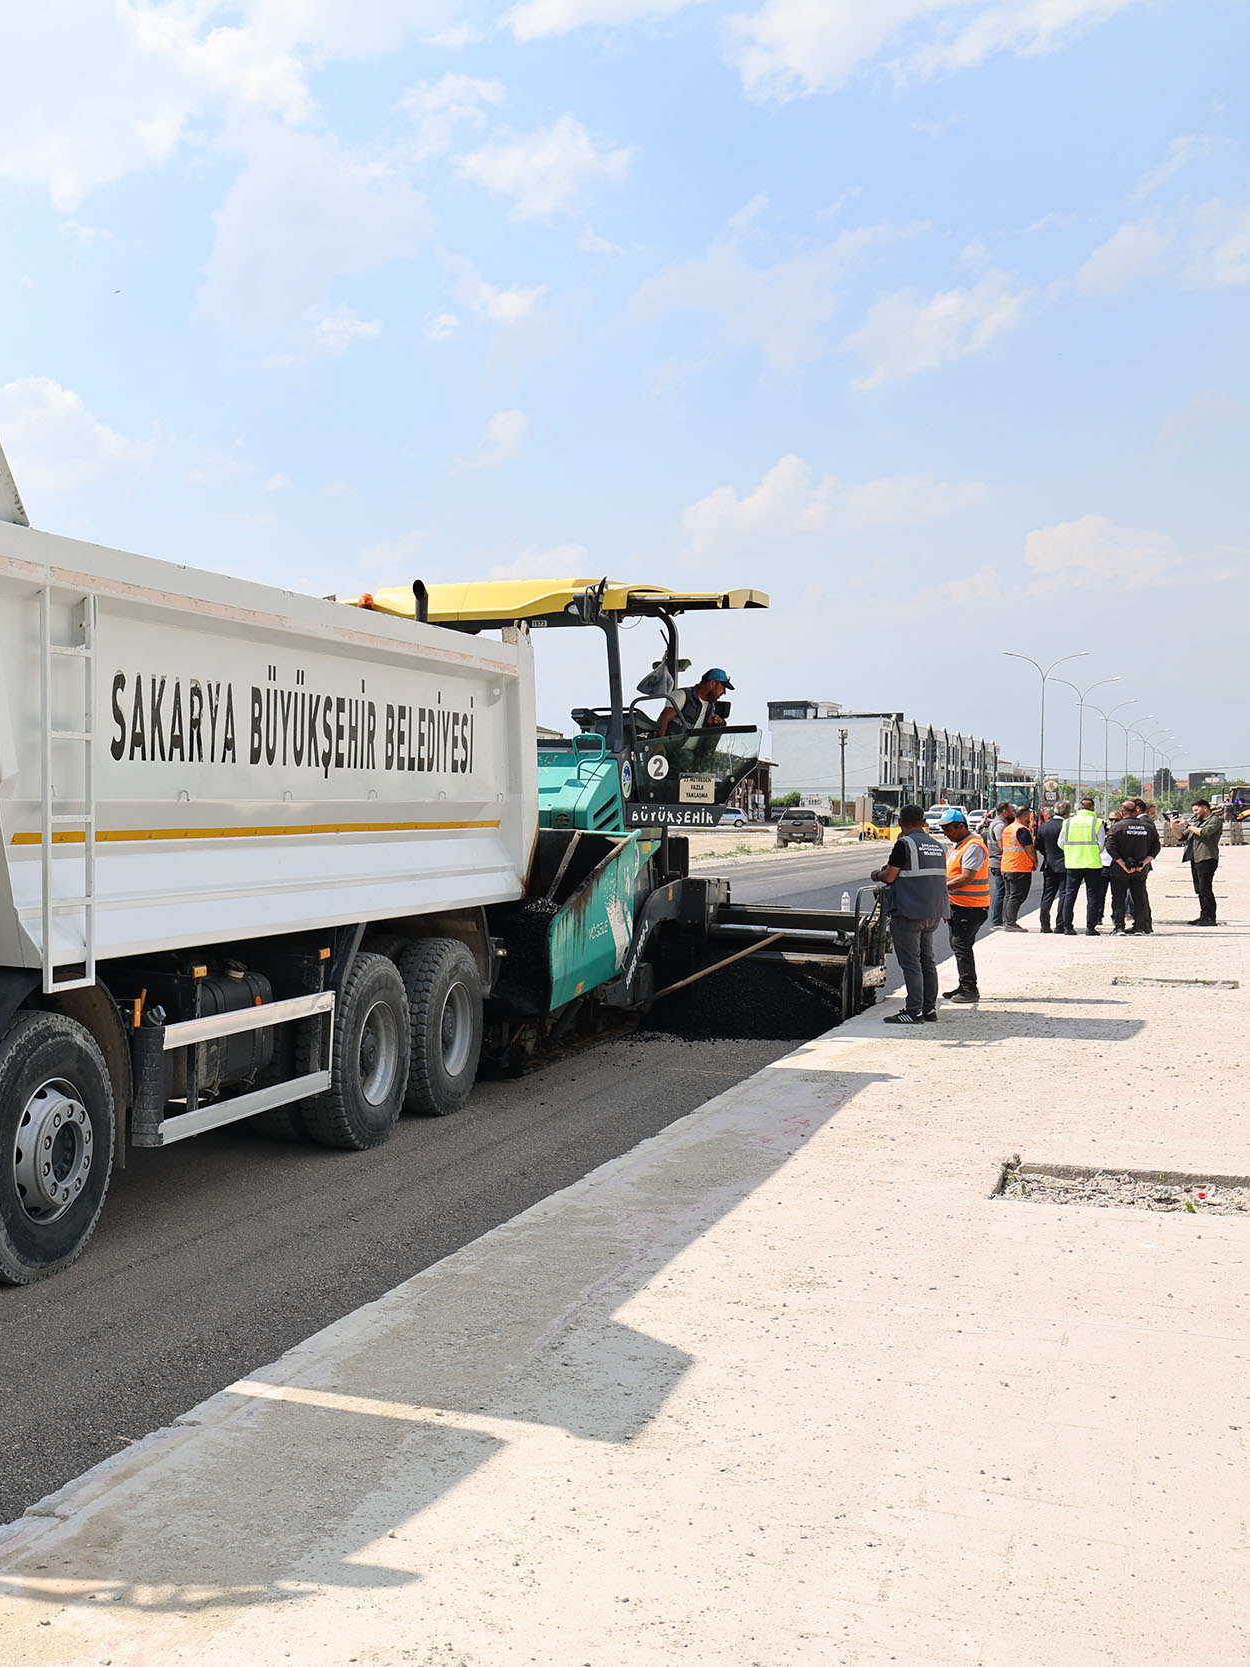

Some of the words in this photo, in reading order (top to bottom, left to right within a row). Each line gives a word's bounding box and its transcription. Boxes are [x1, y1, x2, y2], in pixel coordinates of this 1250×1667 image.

[110, 669, 237, 763] SAKARYA
[250, 665, 376, 779] BÜYÜKŞEHİR
[385, 691, 474, 774] BELEDİYESİ
[653, 758, 664, 777] 2
[631, 806, 714, 825] BÜYÜKŞEHİR
